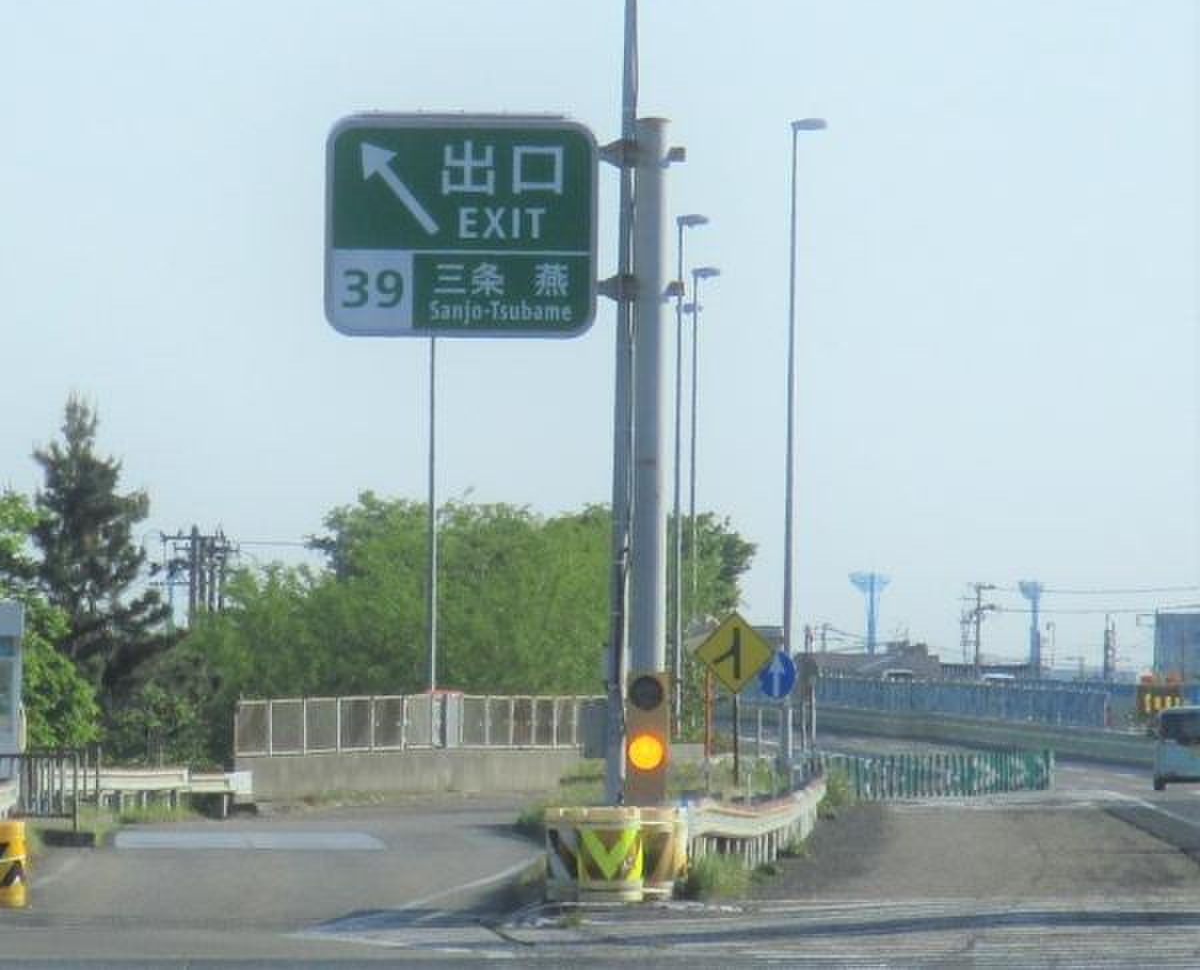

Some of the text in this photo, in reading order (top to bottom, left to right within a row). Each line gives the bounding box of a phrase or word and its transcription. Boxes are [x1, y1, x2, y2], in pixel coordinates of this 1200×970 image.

[441, 139, 564, 195] 出口
[458, 206, 546, 239] EXIT
[341, 268, 405, 309] 39
[433, 262, 570, 296] 三条 燕
[429, 299, 573, 324] Sanjo-Tsubame
